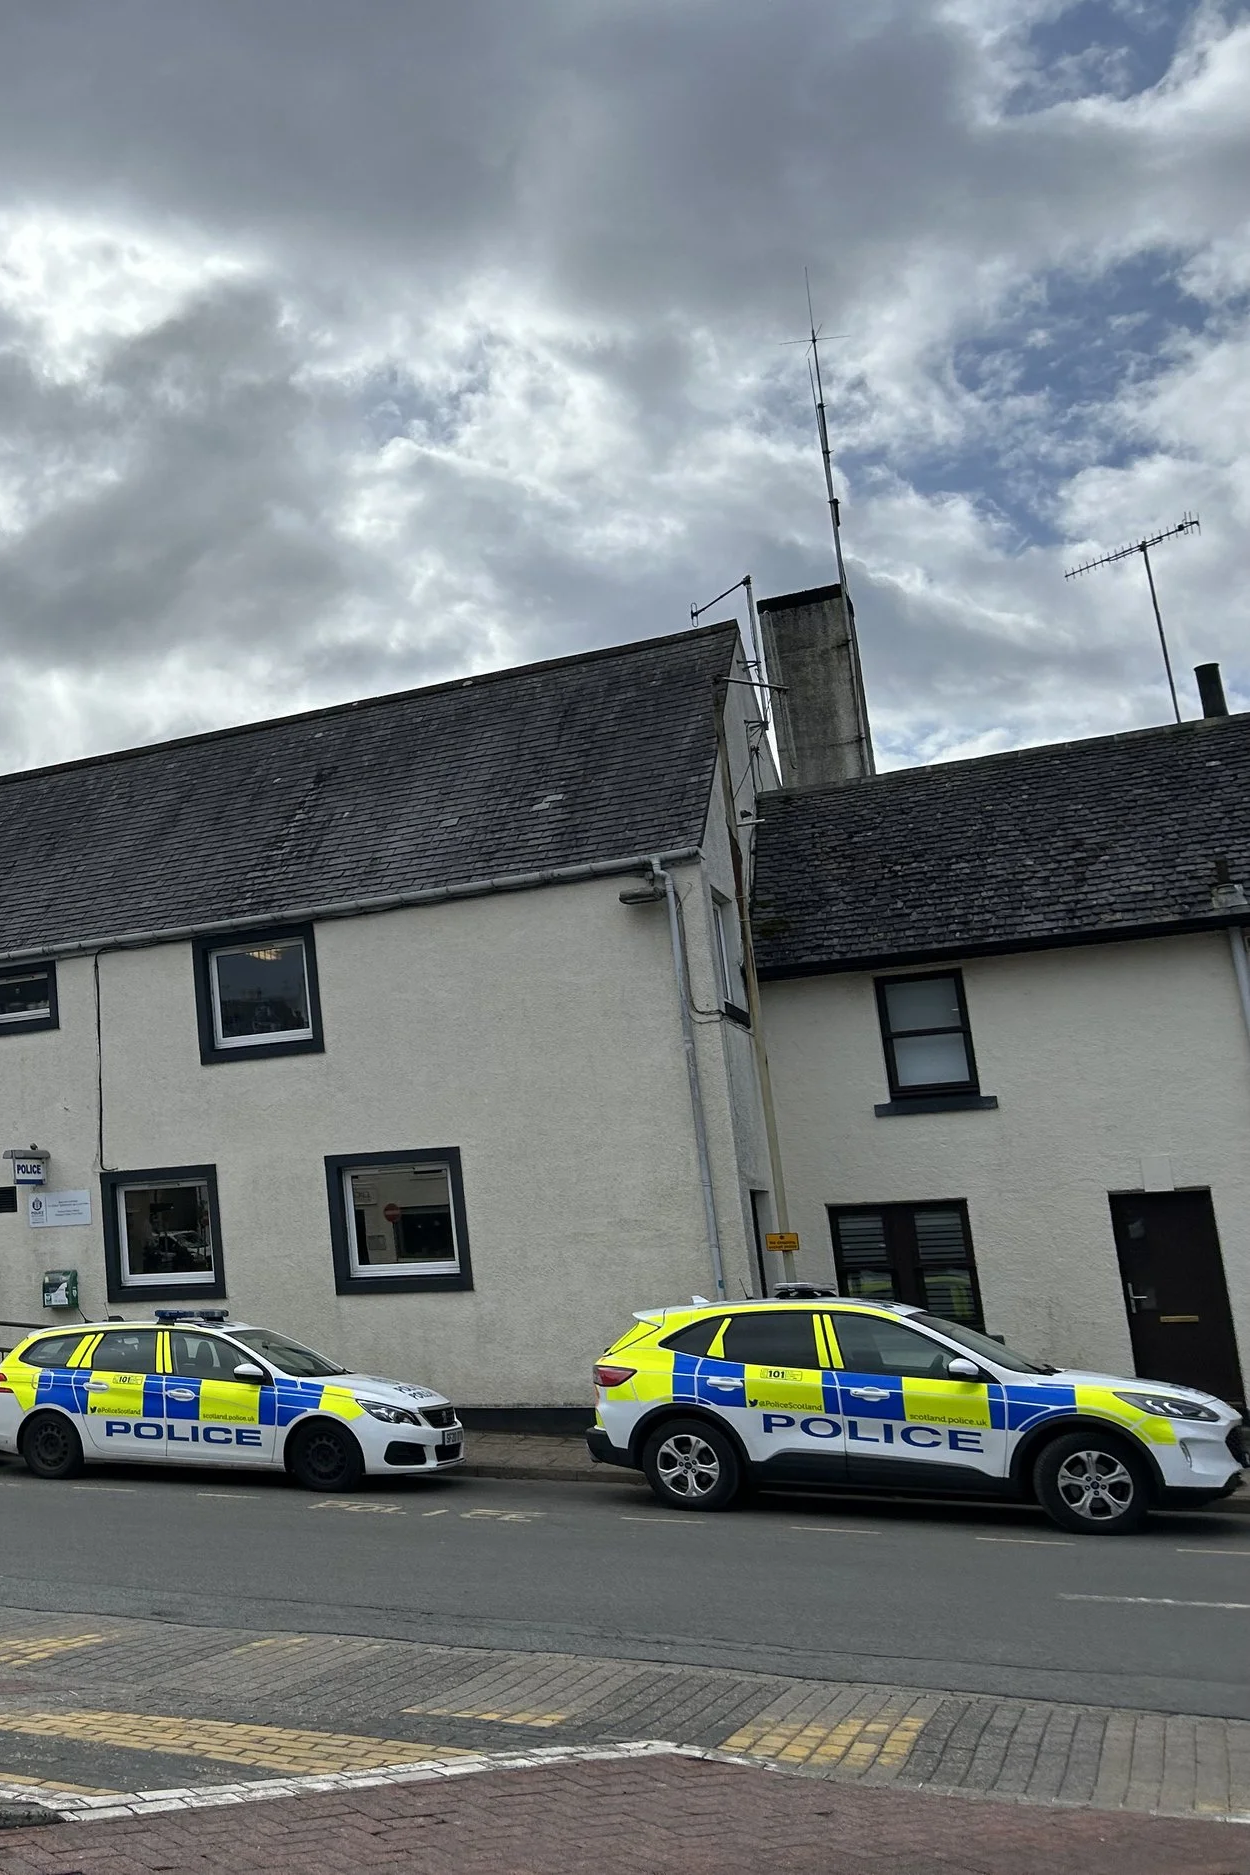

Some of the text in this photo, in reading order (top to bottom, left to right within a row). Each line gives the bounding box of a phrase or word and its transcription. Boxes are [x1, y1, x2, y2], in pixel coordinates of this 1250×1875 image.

[16, 1164, 41, 1174] POLICE
[768, 1370, 785, 1379] 101
[97, 1406, 141, 1415] @PoliceScotland
[759, 1401, 823, 1412] @PoliceScotland
[202, 1413, 255, 1422] scotland.police.uk
[909, 1413, 989, 1426] scotland.police.uk
[105, 1420, 263, 1447] POLICE
[762, 1413, 985, 1454] POLICE
